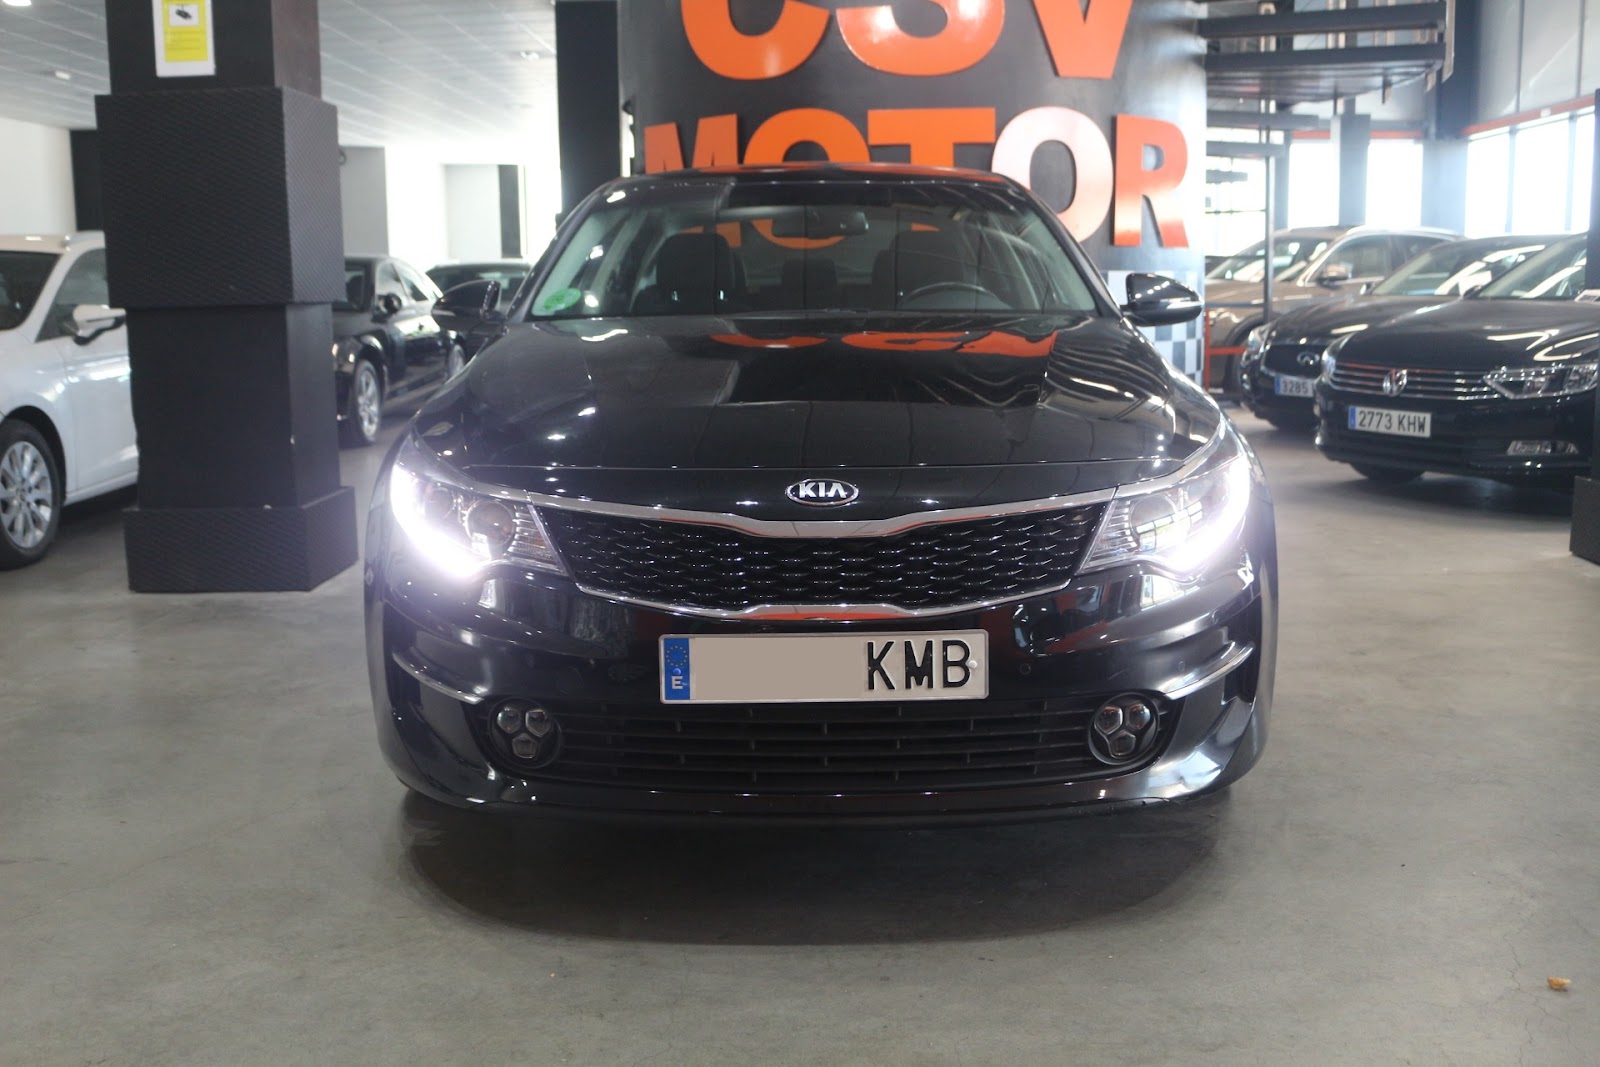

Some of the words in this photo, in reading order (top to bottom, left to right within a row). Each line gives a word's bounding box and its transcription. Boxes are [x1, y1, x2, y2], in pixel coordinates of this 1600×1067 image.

[1358, 410, 1393, 430] 2773
[1397, 414, 1427, 433] KHW
[799, 482, 847, 499] KIA
[867, 640, 971, 690] KMB
[672, 676, 683, 689] E
